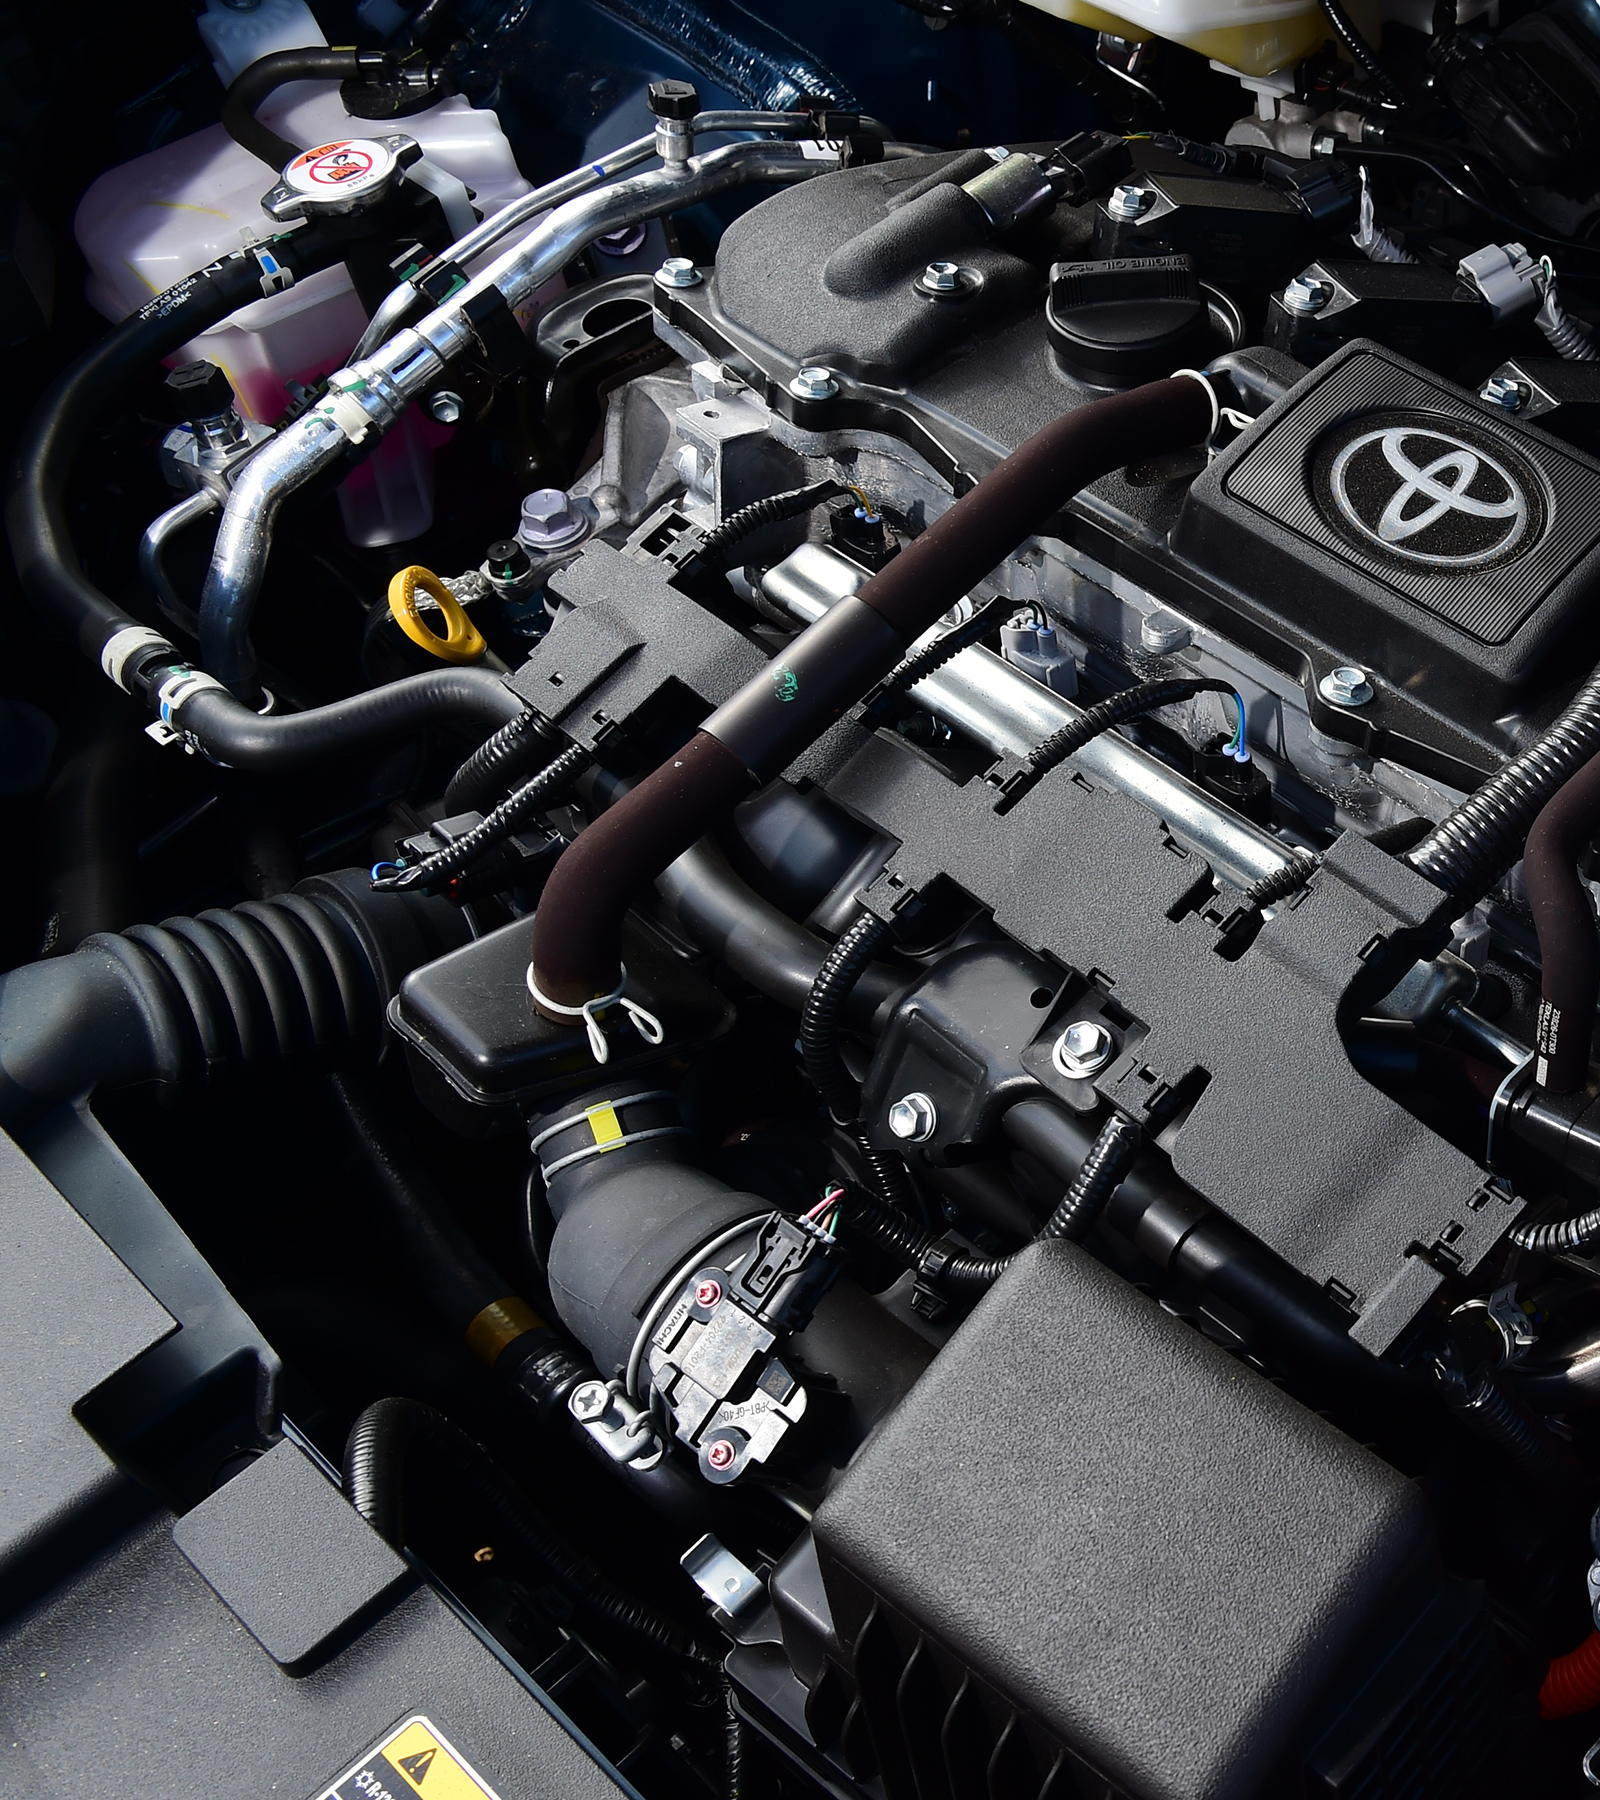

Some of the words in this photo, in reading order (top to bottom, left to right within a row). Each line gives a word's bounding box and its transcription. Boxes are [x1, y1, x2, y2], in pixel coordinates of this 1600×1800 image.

[1103, 261, 1126, 270] OIL
[1131, 257, 1187, 268] ENGINE
[656, 1303, 688, 1346] HITACHI
